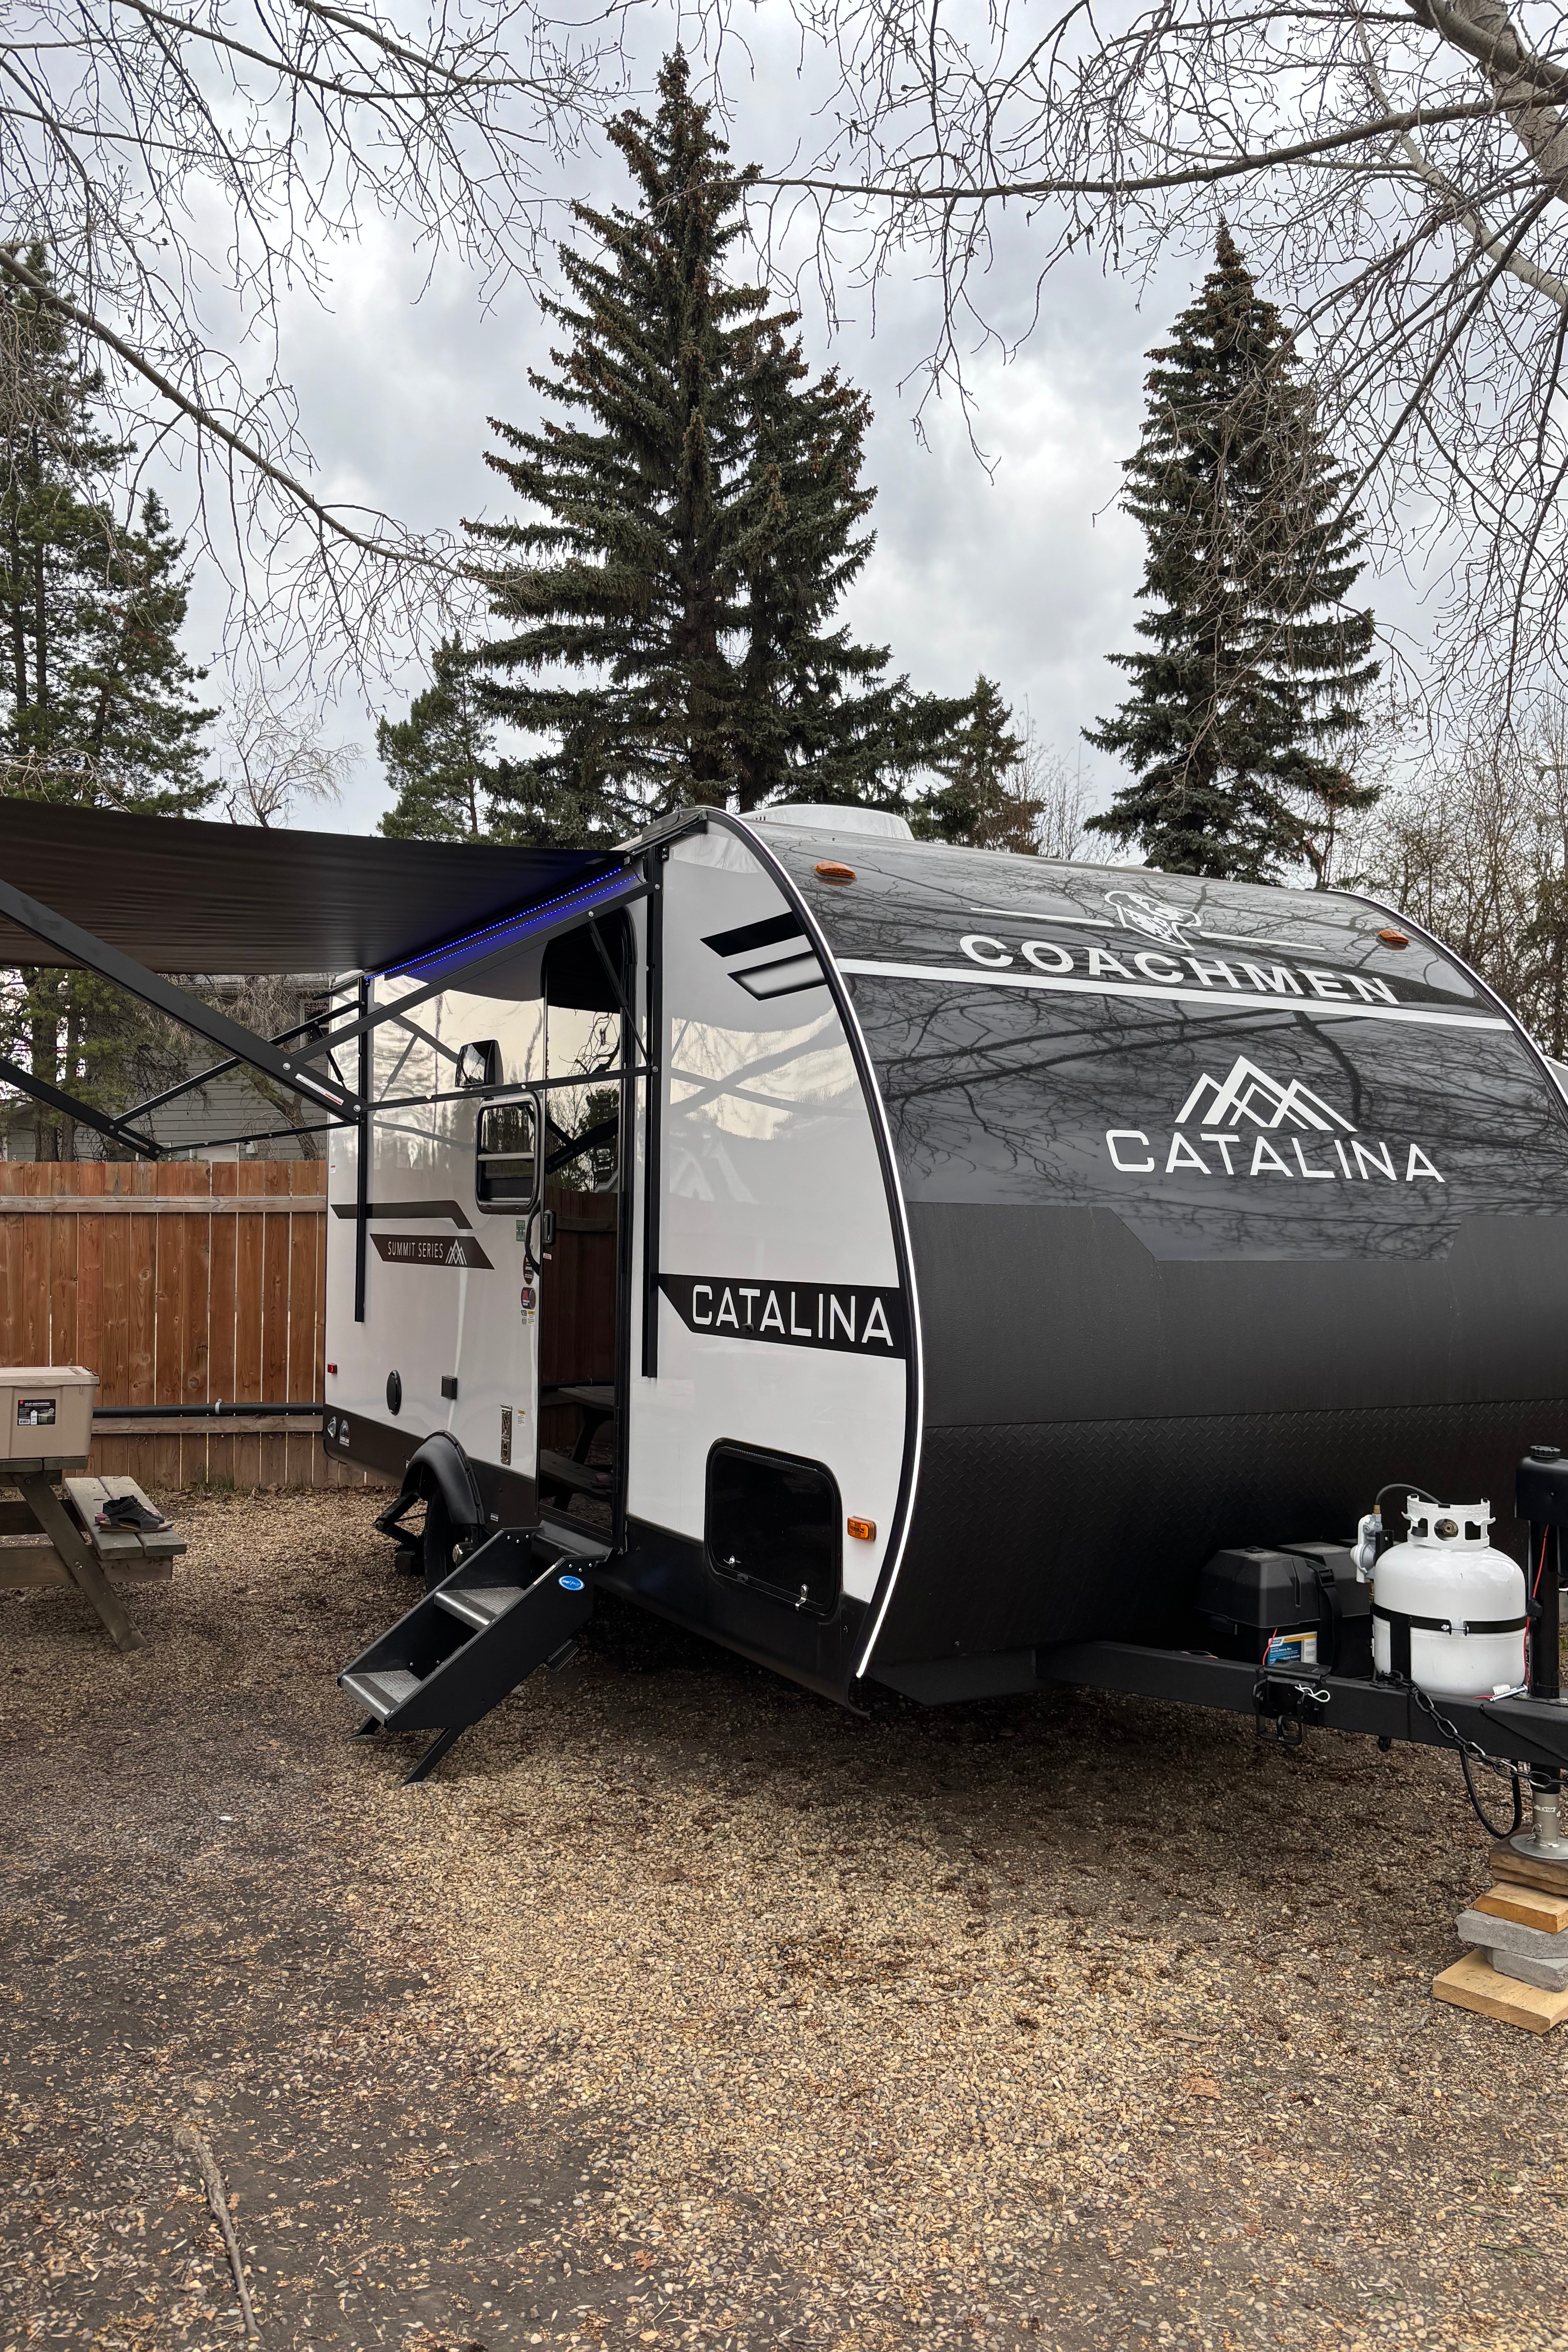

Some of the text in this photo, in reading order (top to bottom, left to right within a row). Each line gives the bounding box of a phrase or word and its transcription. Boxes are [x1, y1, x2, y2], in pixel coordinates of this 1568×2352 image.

[960, 935, 1400, 1005] COACHMEN
[1106, 1129, 1445, 1183] CATALINA
[388, 1241, 443, 1258] SUMMIT SERIES
[693, 1285, 894, 1346] CATALINA
